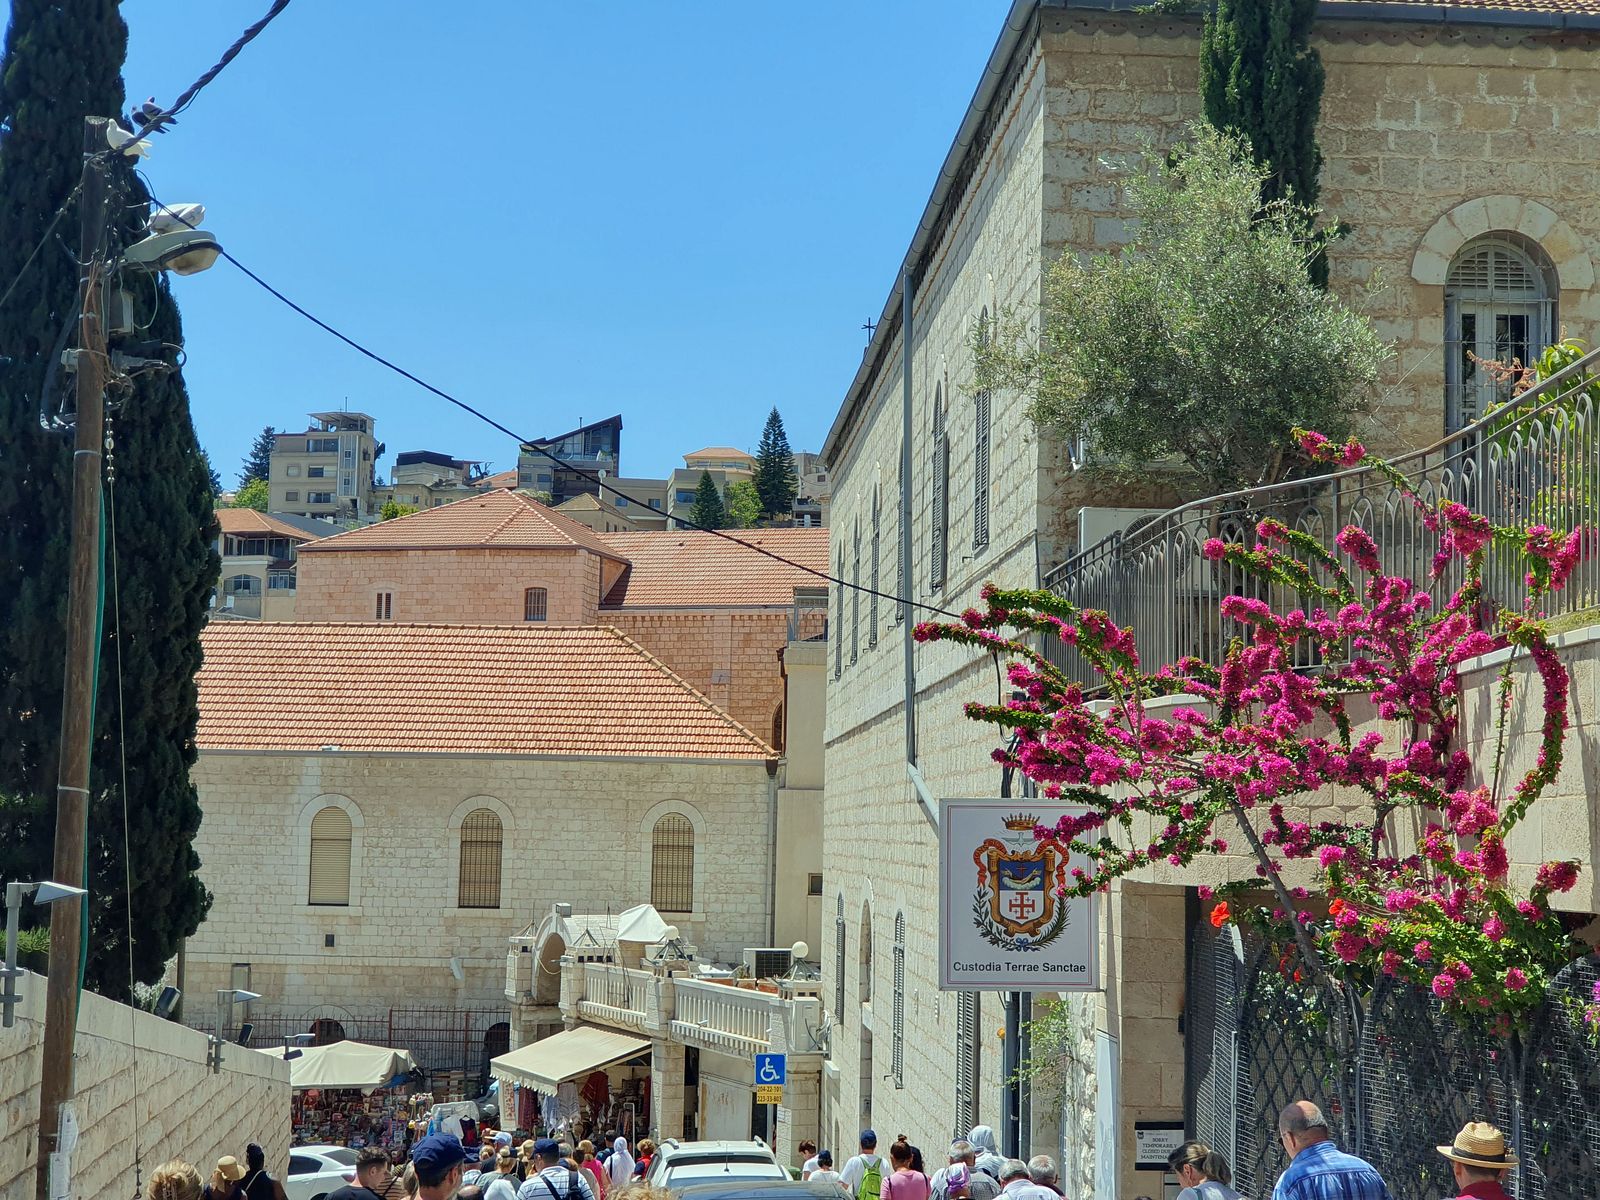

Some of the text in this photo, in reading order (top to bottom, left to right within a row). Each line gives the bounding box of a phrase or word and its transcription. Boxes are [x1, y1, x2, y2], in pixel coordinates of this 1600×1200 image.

[953, 961, 1086, 973] Custodia Terrae Sanctae
